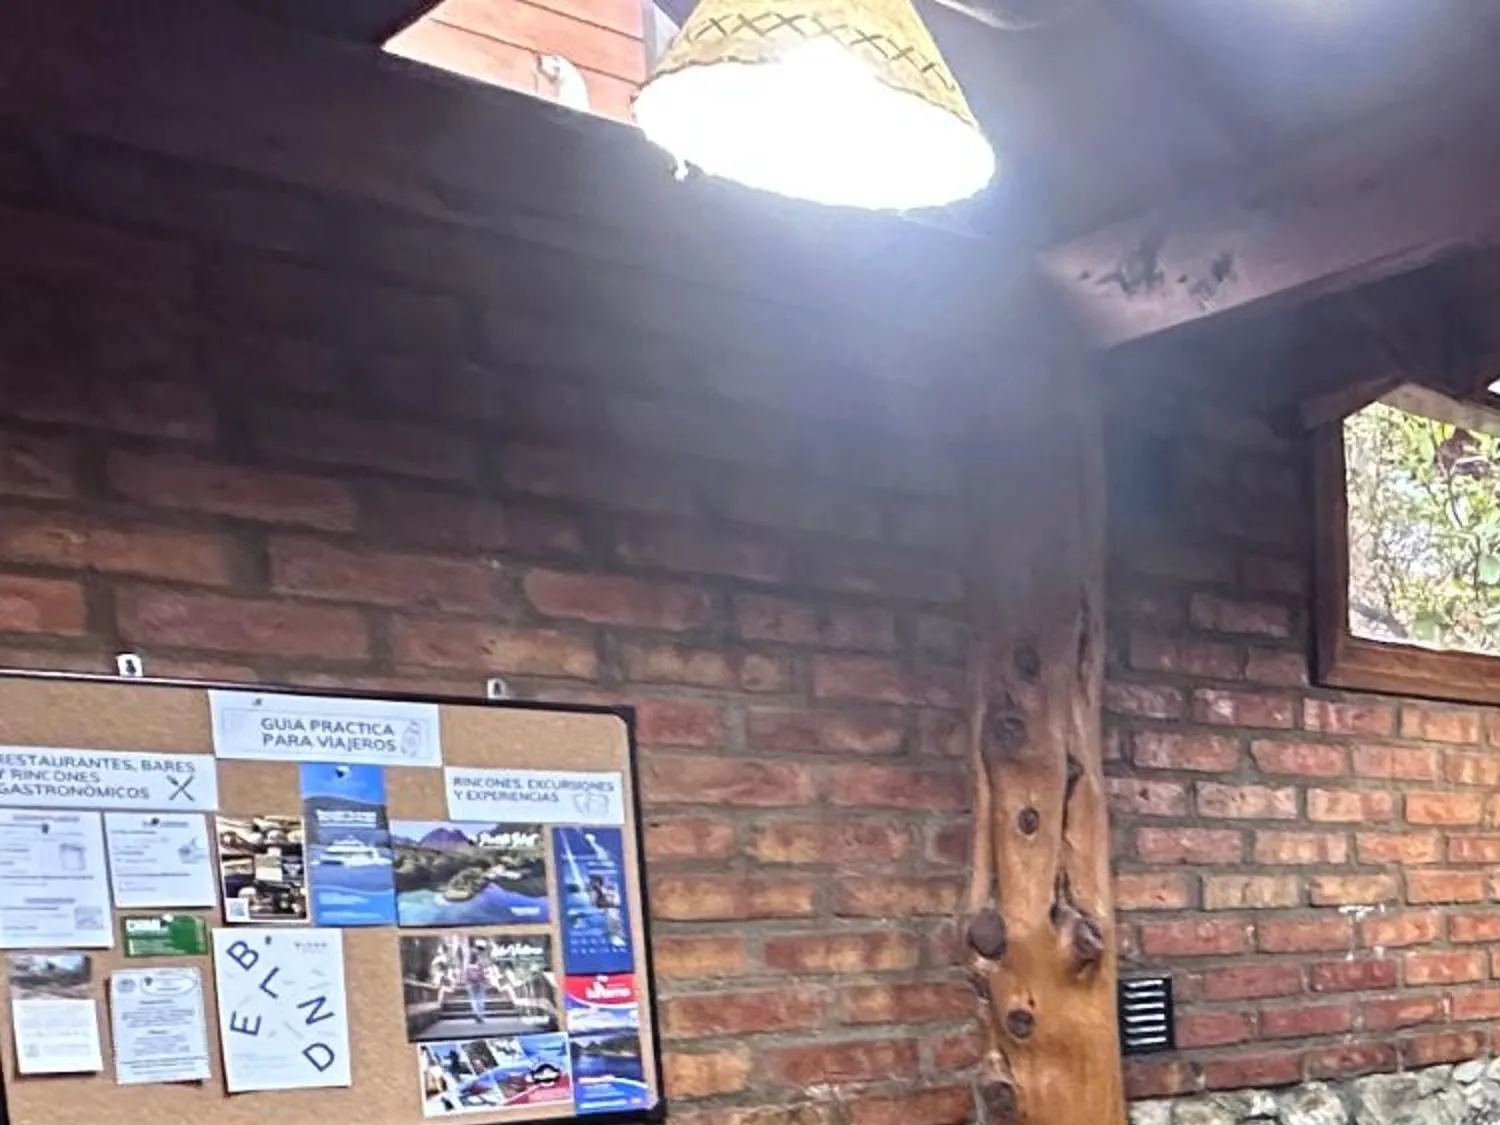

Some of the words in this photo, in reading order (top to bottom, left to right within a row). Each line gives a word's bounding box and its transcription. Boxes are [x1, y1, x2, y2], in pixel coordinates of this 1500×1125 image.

[263, 733, 314, 748] PARA
[317, 735, 397, 752] VIAJEROS
[11, 770, 101, 783] RINCONES
[141, 759, 196, 773] BARES
[466, 789, 560, 803] EXPERIENCIAS
[226, 940, 260, 971] B
[258, 966, 280, 999] L
[229, 1010, 263, 1037] E
[301, 1042, 336, 1073] D
